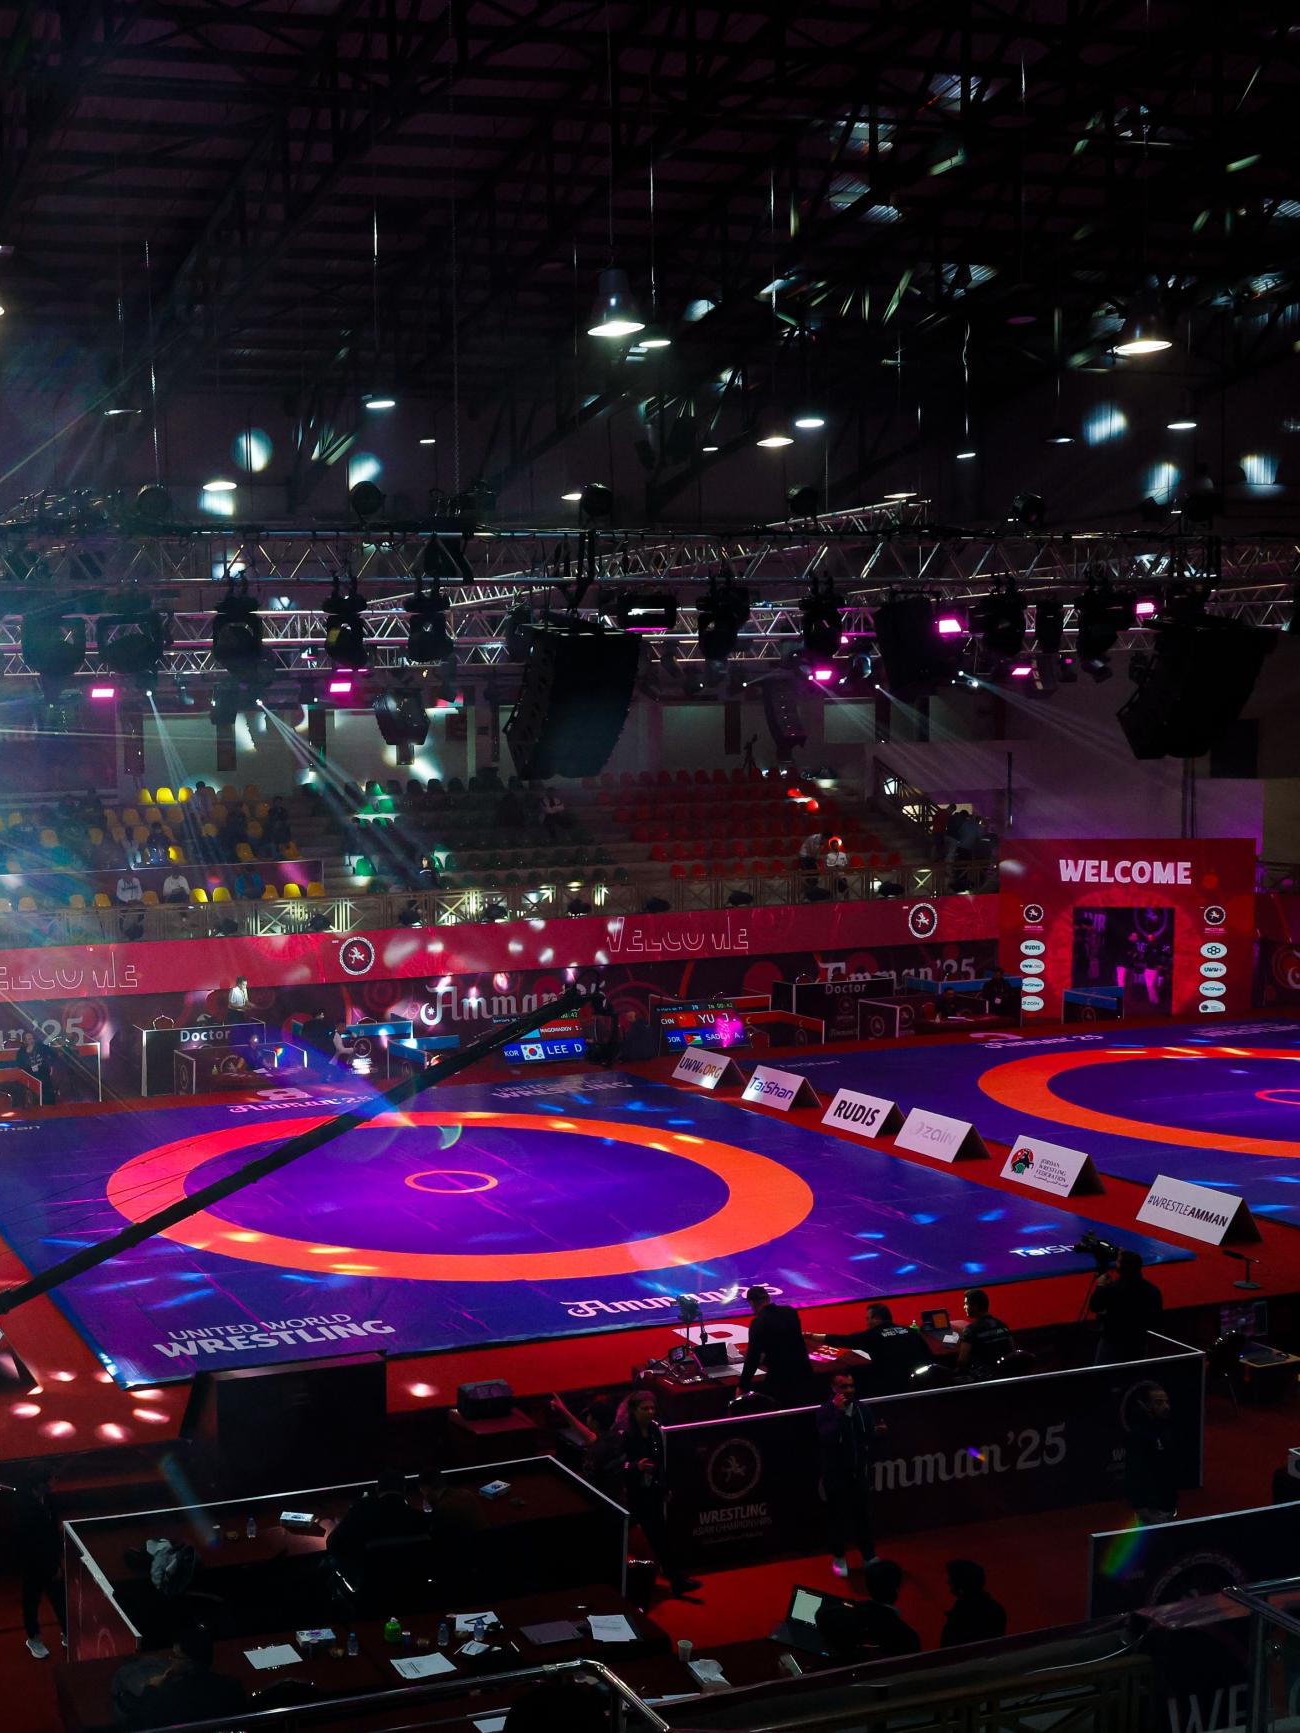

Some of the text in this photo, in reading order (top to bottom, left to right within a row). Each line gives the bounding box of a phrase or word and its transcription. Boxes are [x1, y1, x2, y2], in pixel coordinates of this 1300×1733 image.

[1059, 858, 1192, 886] WELCOME
[825, 982, 867, 995] Doctor
[698, 1013, 715, 1024] YU
[179, 1027, 229, 1043] Doctor
[504, 1049, 520, 1057] KOR
[546, 1044, 569, 1055] LEE
[679, 1057, 722, 1078] UWW.ORG
[748, 1076, 795, 1100] TaiShan
[833, 1100, 880, 1127] RUDIS
[1147, 1194, 1229, 1228] #WRESTLEAMMAN
[153, 1320, 396, 1358] WRESTLING
[168, 1313, 351, 1341] UNITED WORLD
[873, 1421, 1067, 1492] mman'25
[698, 1502, 768, 1525] WRESTLING
